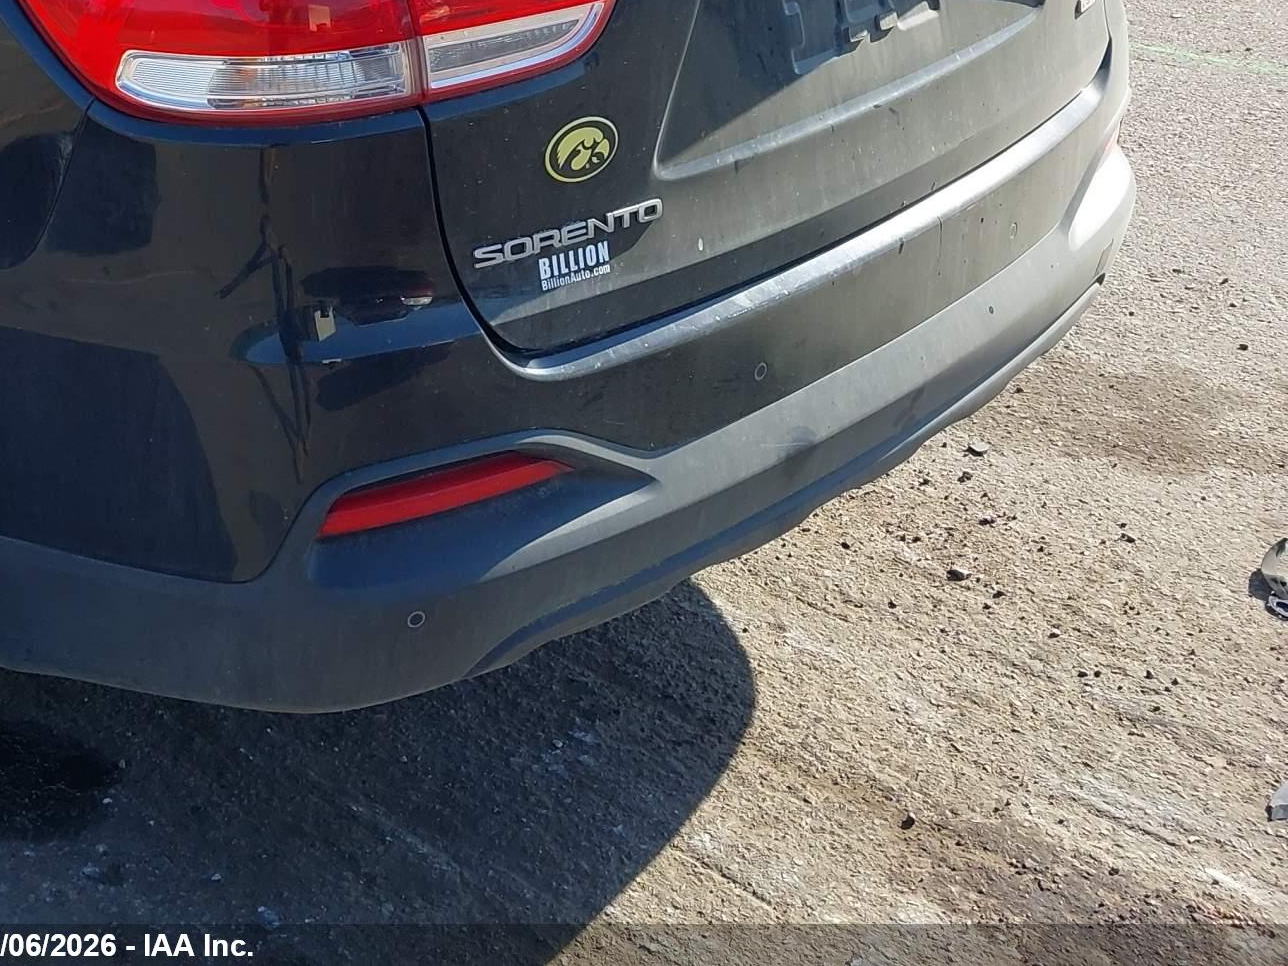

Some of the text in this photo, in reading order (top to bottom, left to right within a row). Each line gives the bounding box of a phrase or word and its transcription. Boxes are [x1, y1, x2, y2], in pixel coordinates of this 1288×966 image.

[473, 198, 663, 269] SORENTO
[538, 241, 610, 280] BILLION
[541, 264, 611, 291] BillionAuto.com
